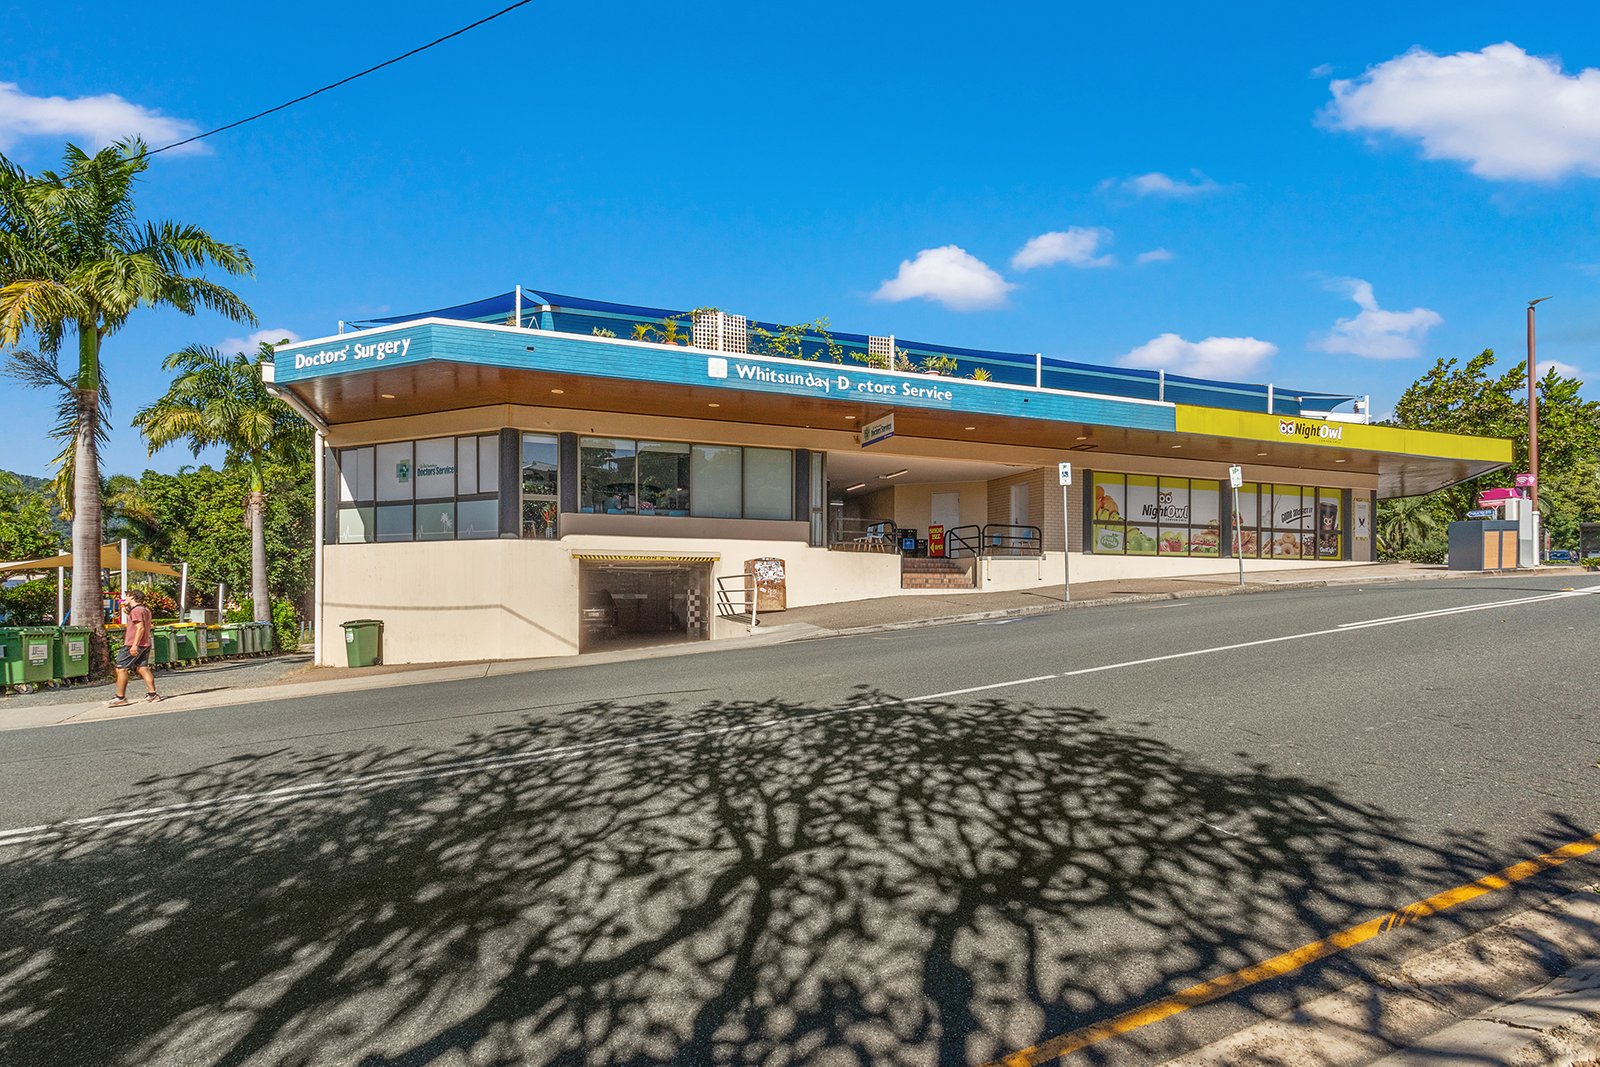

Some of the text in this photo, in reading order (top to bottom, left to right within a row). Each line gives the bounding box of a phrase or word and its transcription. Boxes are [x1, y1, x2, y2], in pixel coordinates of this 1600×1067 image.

[295, 338, 411, 369] Doctors' Surgery
[735, 363, 830, 393] Whitsunday
[902, 382, 953, 401] Service
[417, 467, 436, 477] Doctors
